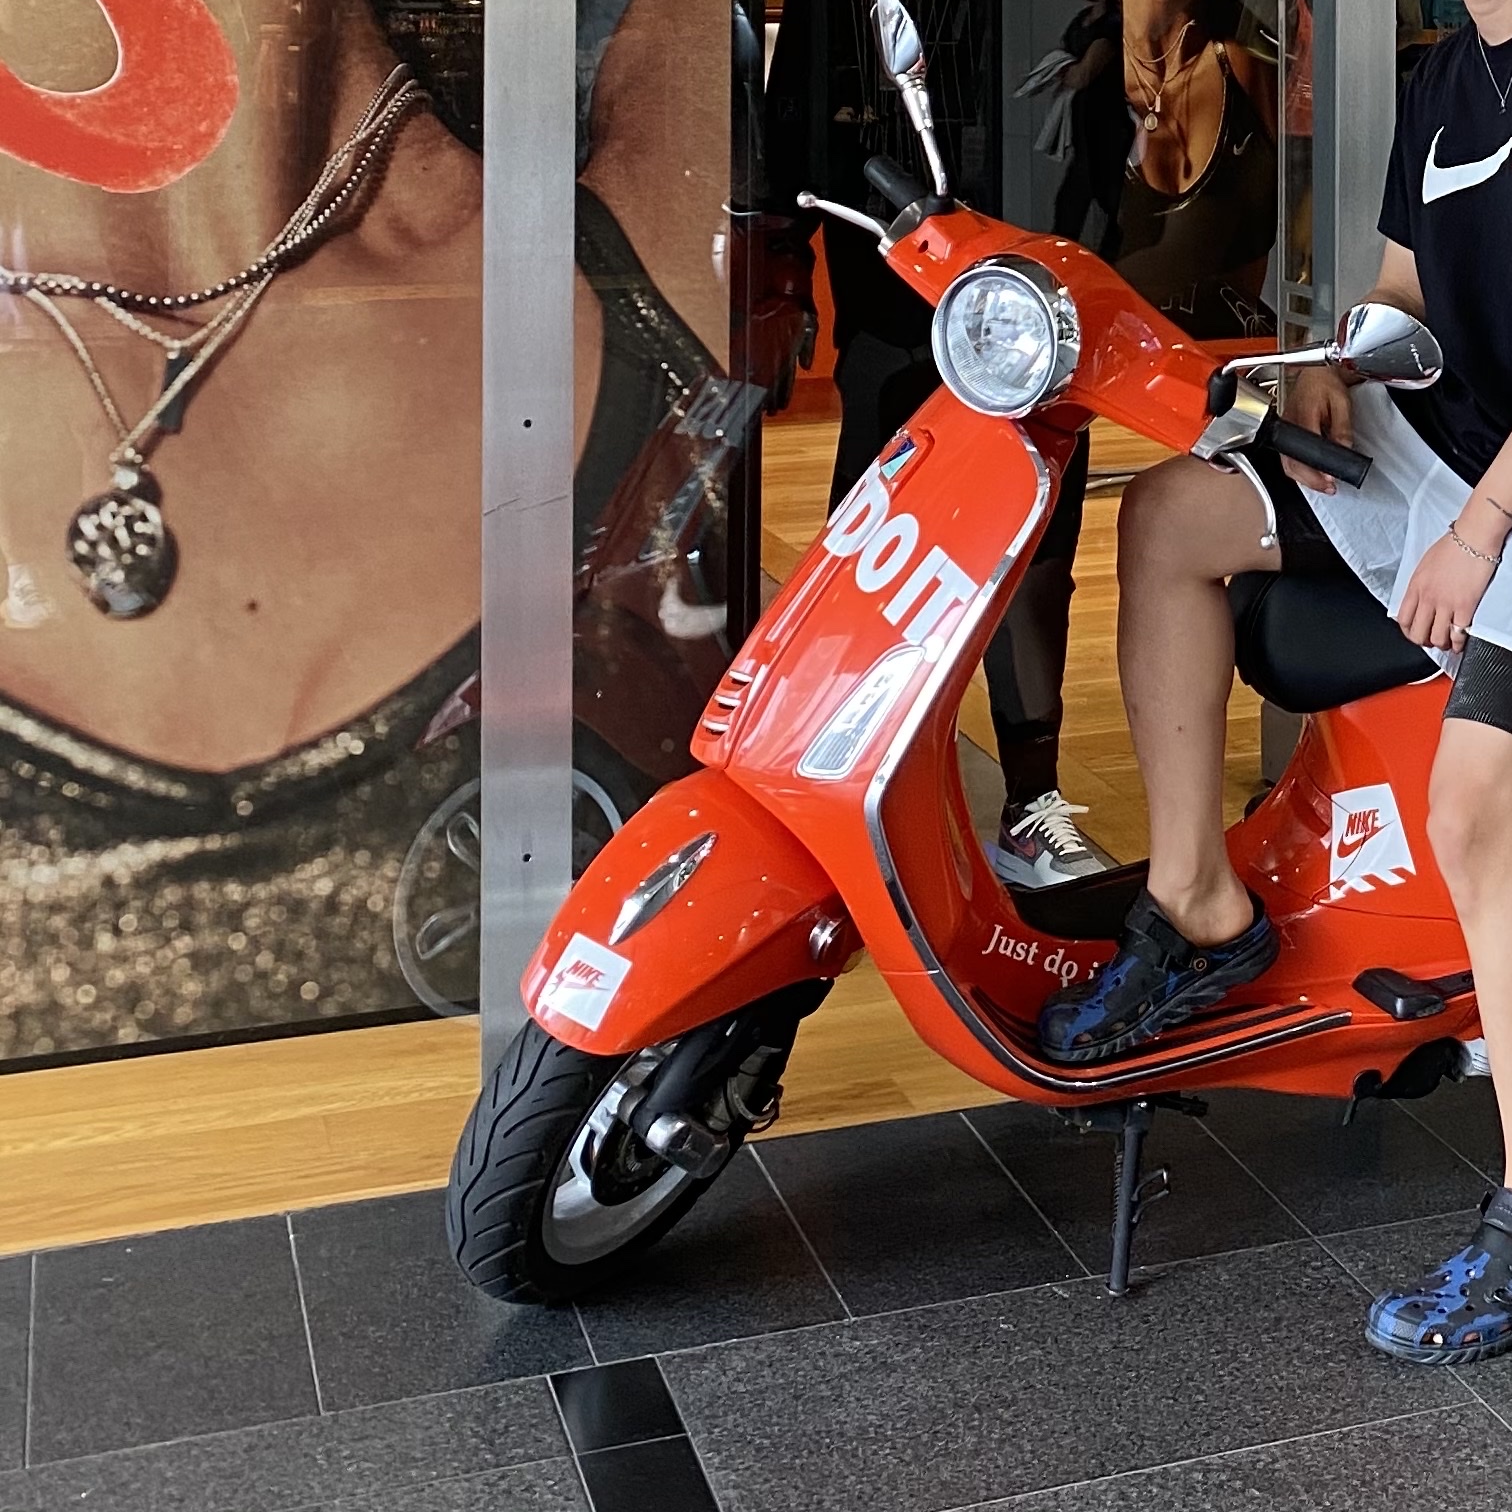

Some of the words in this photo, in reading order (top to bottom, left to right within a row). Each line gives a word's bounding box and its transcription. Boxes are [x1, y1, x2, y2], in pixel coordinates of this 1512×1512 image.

[822, 468, 920, 593] DO
[1345, 808, 1380, 838] NIKE
[981, 923, 1039, 966] Just
[566, 959, 607, 988] NIKE
